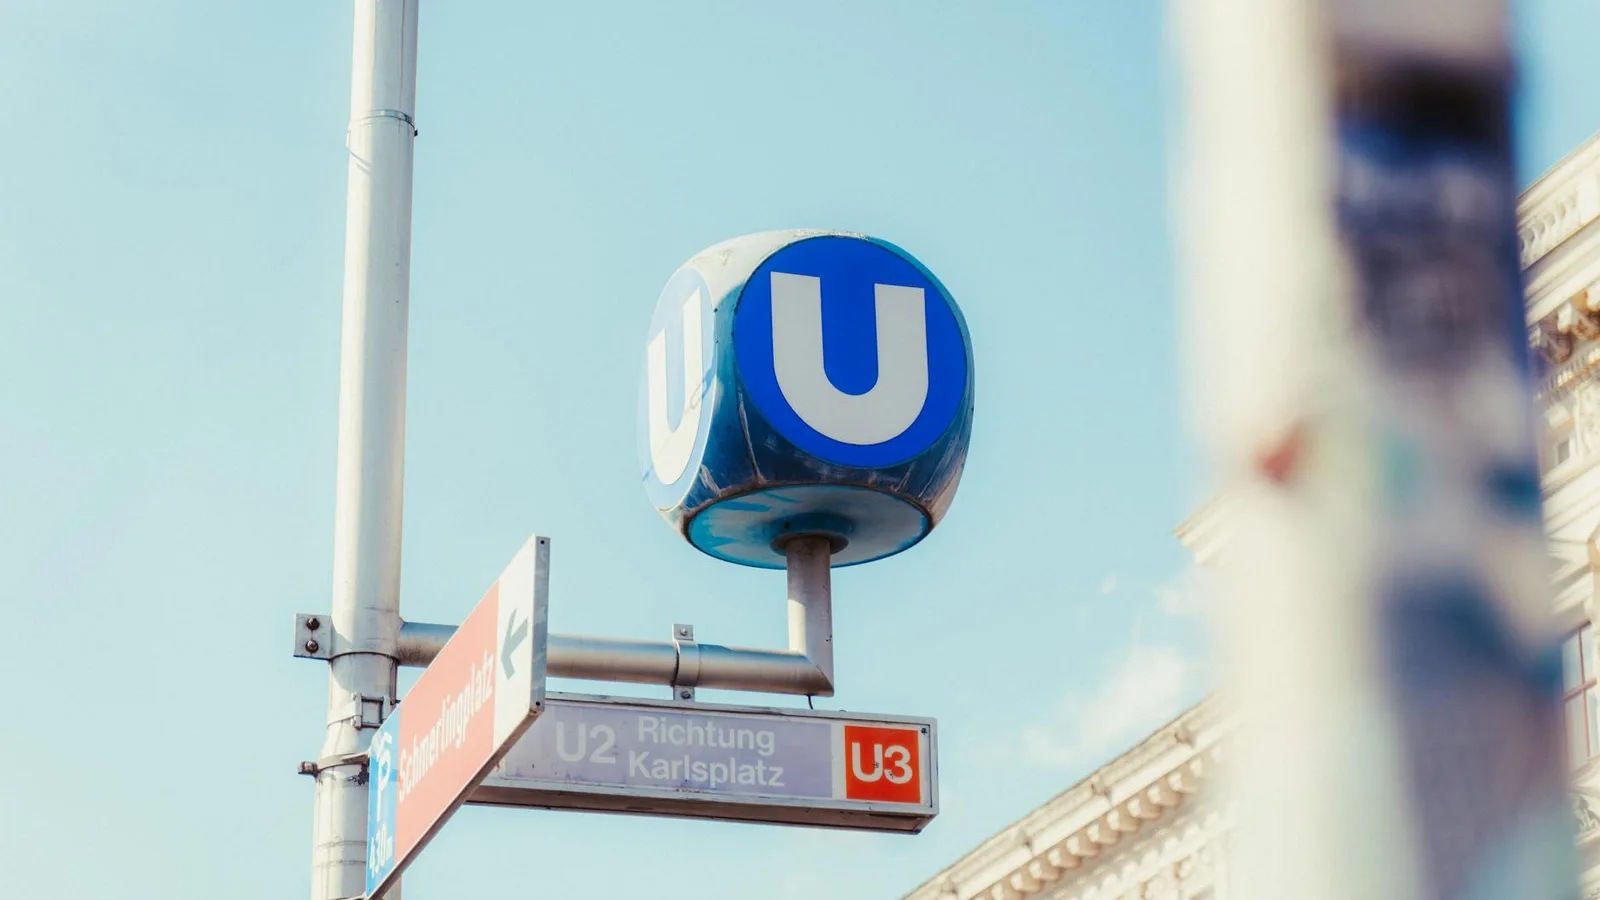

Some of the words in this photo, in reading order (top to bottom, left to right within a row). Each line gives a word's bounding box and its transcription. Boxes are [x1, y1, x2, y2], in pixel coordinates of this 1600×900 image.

[648, 286, 703, 486] U
[770, 271, 929, 446] U
[399, 648, 494, 803] Schmerlingplatz
[556, 721, 616, 764] U2
[638, 715, 775, 757] Richtung
[376, 749, 391, 822] P
[629, 750, 785, 788] Karlsplatz
[851, 741, 914, 785] U3
